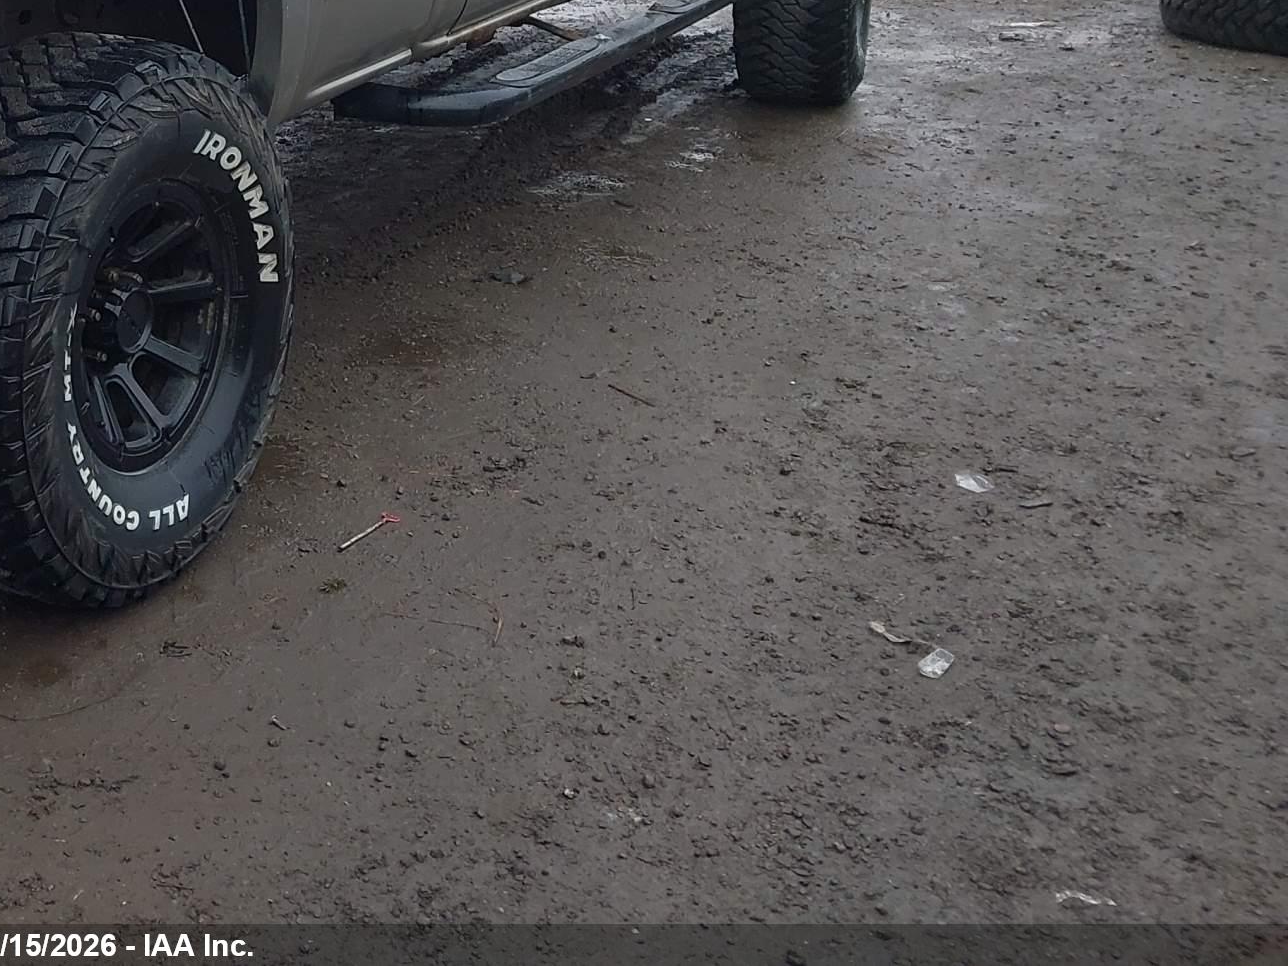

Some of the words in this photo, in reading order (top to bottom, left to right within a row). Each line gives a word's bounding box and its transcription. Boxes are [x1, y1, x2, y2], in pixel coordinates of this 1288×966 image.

[193, 128, 280, 284] IRONMAN
[66, 420, 140, 531] COUNTRY
[149, 493, 190, 531] ALL
